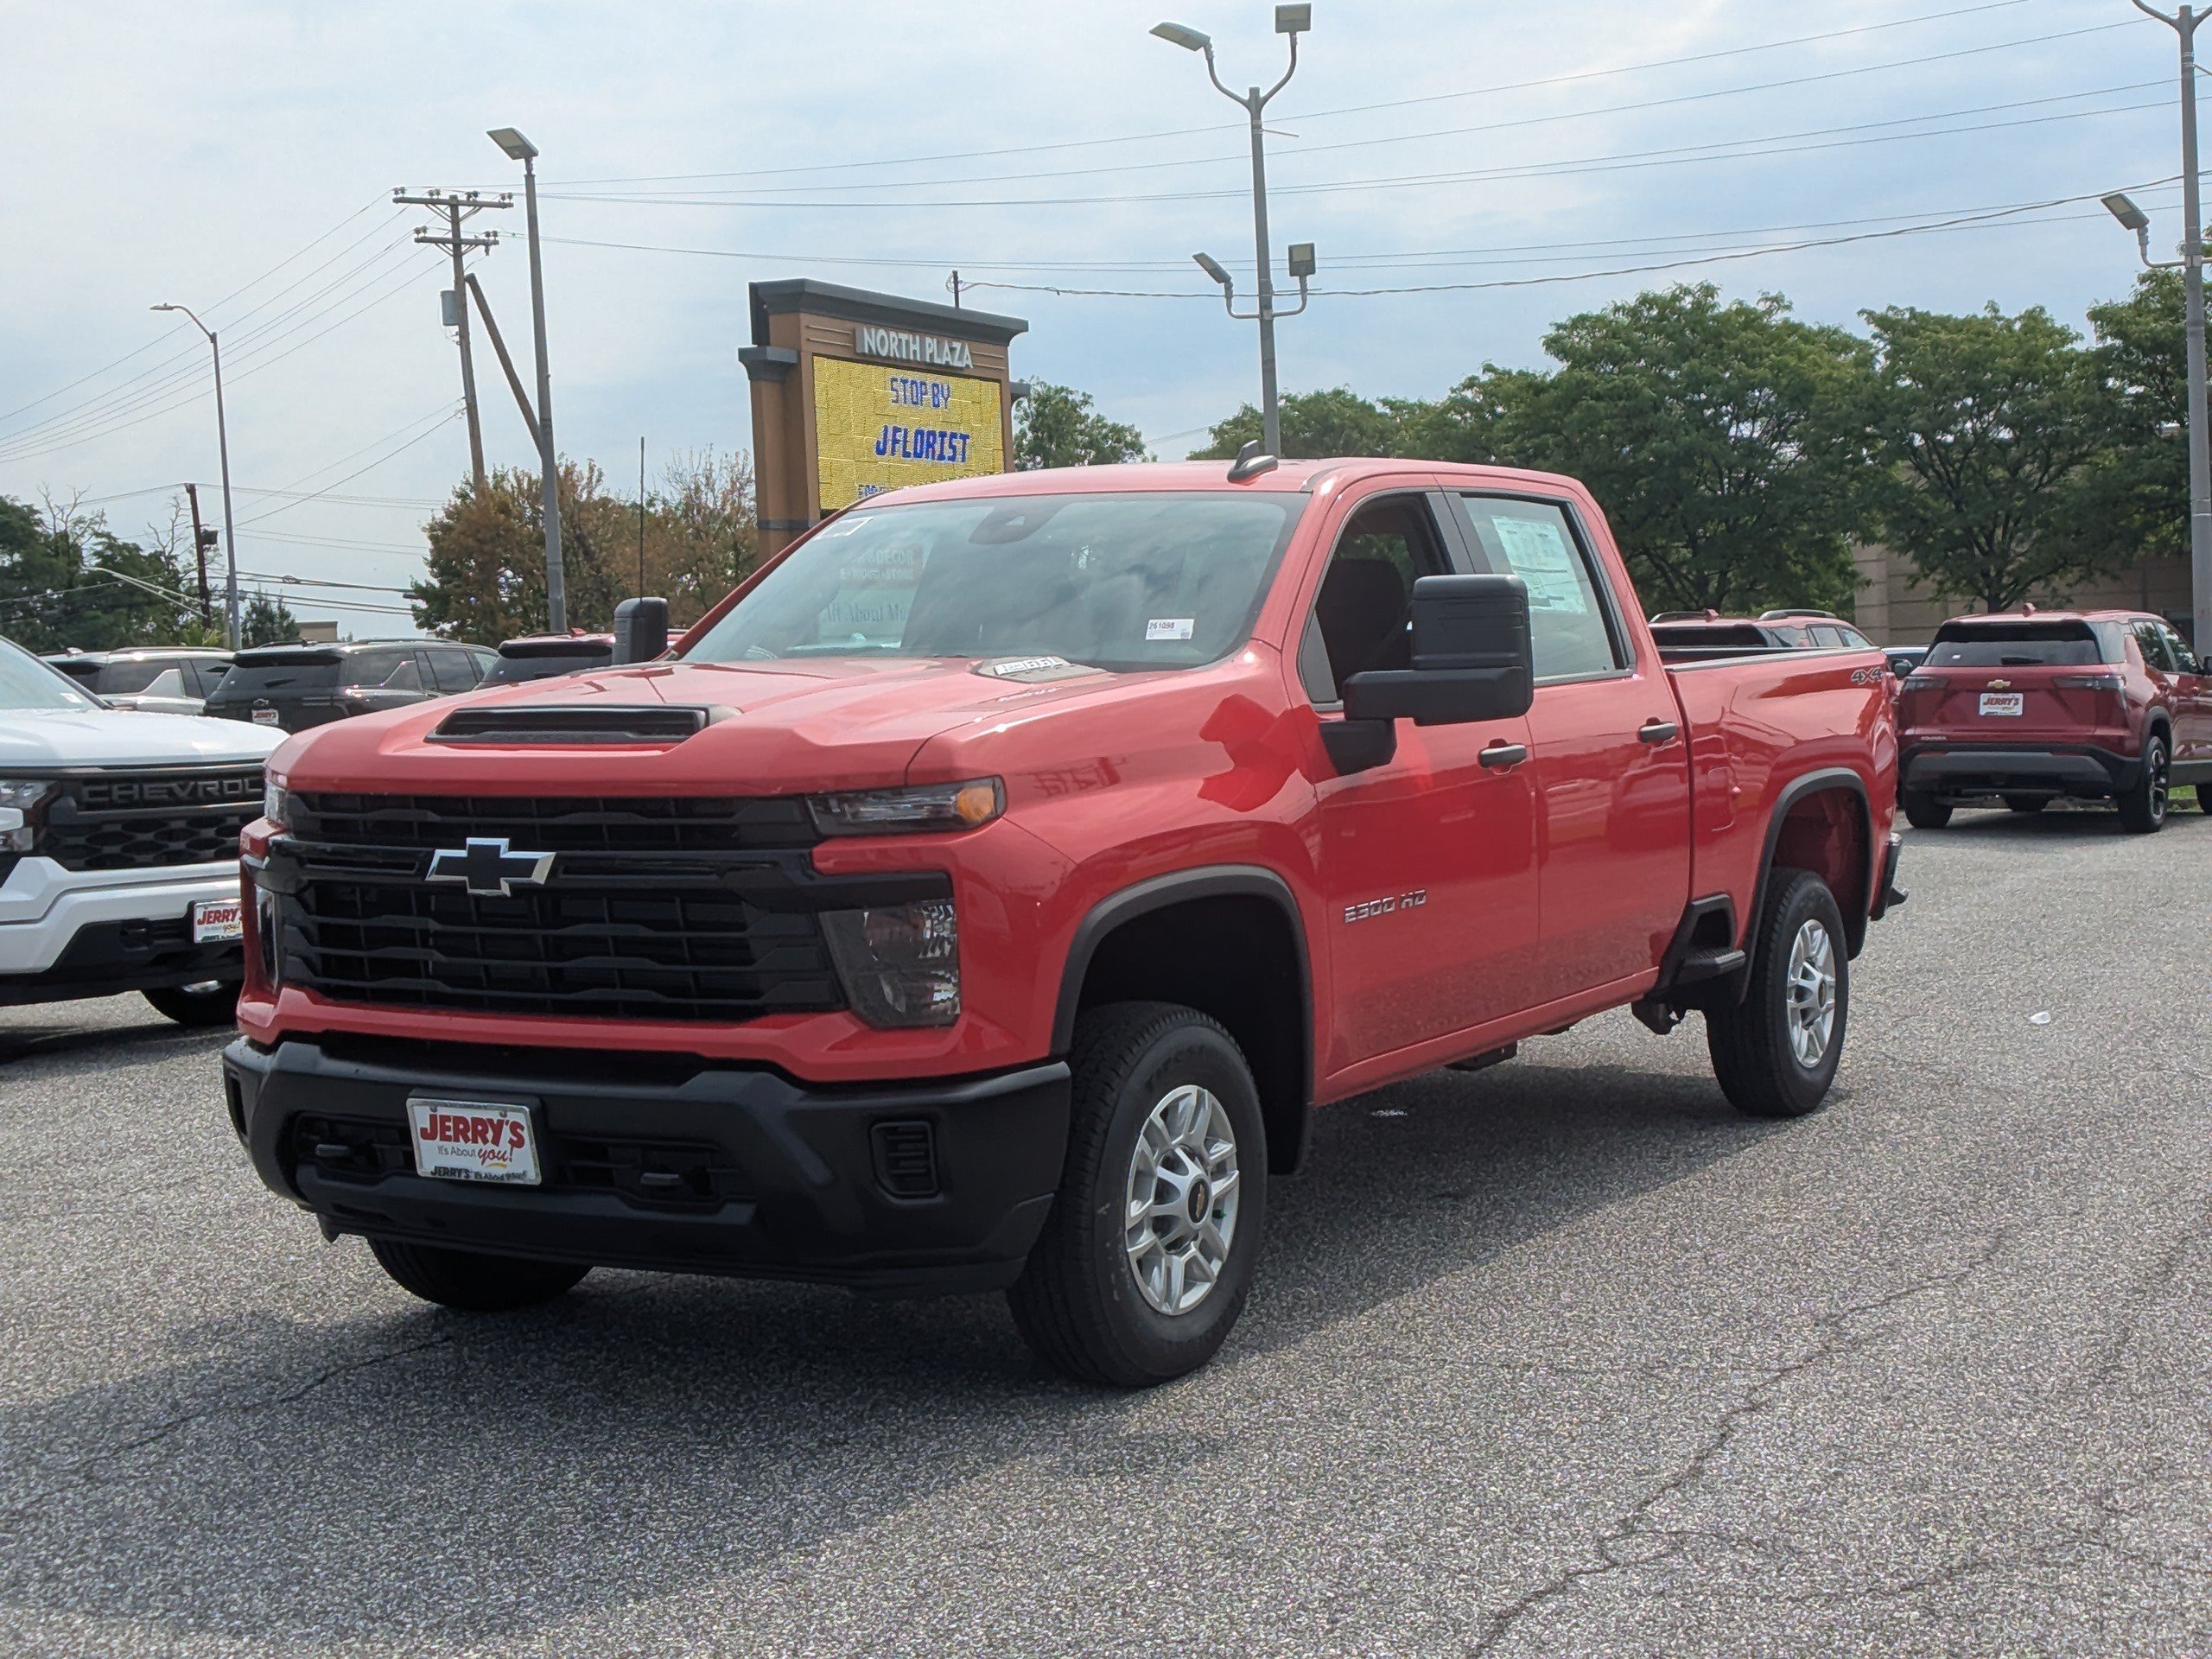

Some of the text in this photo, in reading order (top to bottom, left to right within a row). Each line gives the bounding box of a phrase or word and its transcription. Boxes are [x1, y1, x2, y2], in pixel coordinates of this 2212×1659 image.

[863, 327, 974, 369] NORTH PLAZA
[889, 377, 951, 410] STOP BY
[1983, 697, 2020, 706] JERRY'S
[81, 778, 263, 804] CHEVROL
[197, 907, 242, 925] JERRY'
[1344, 889, 1427, 924] 2500 HD
[420, 1114, 525, 1149] JERRY'S
[477, 1145, 515, 1166] you!
[430, 1166, 472, 1179] JERRY'S
